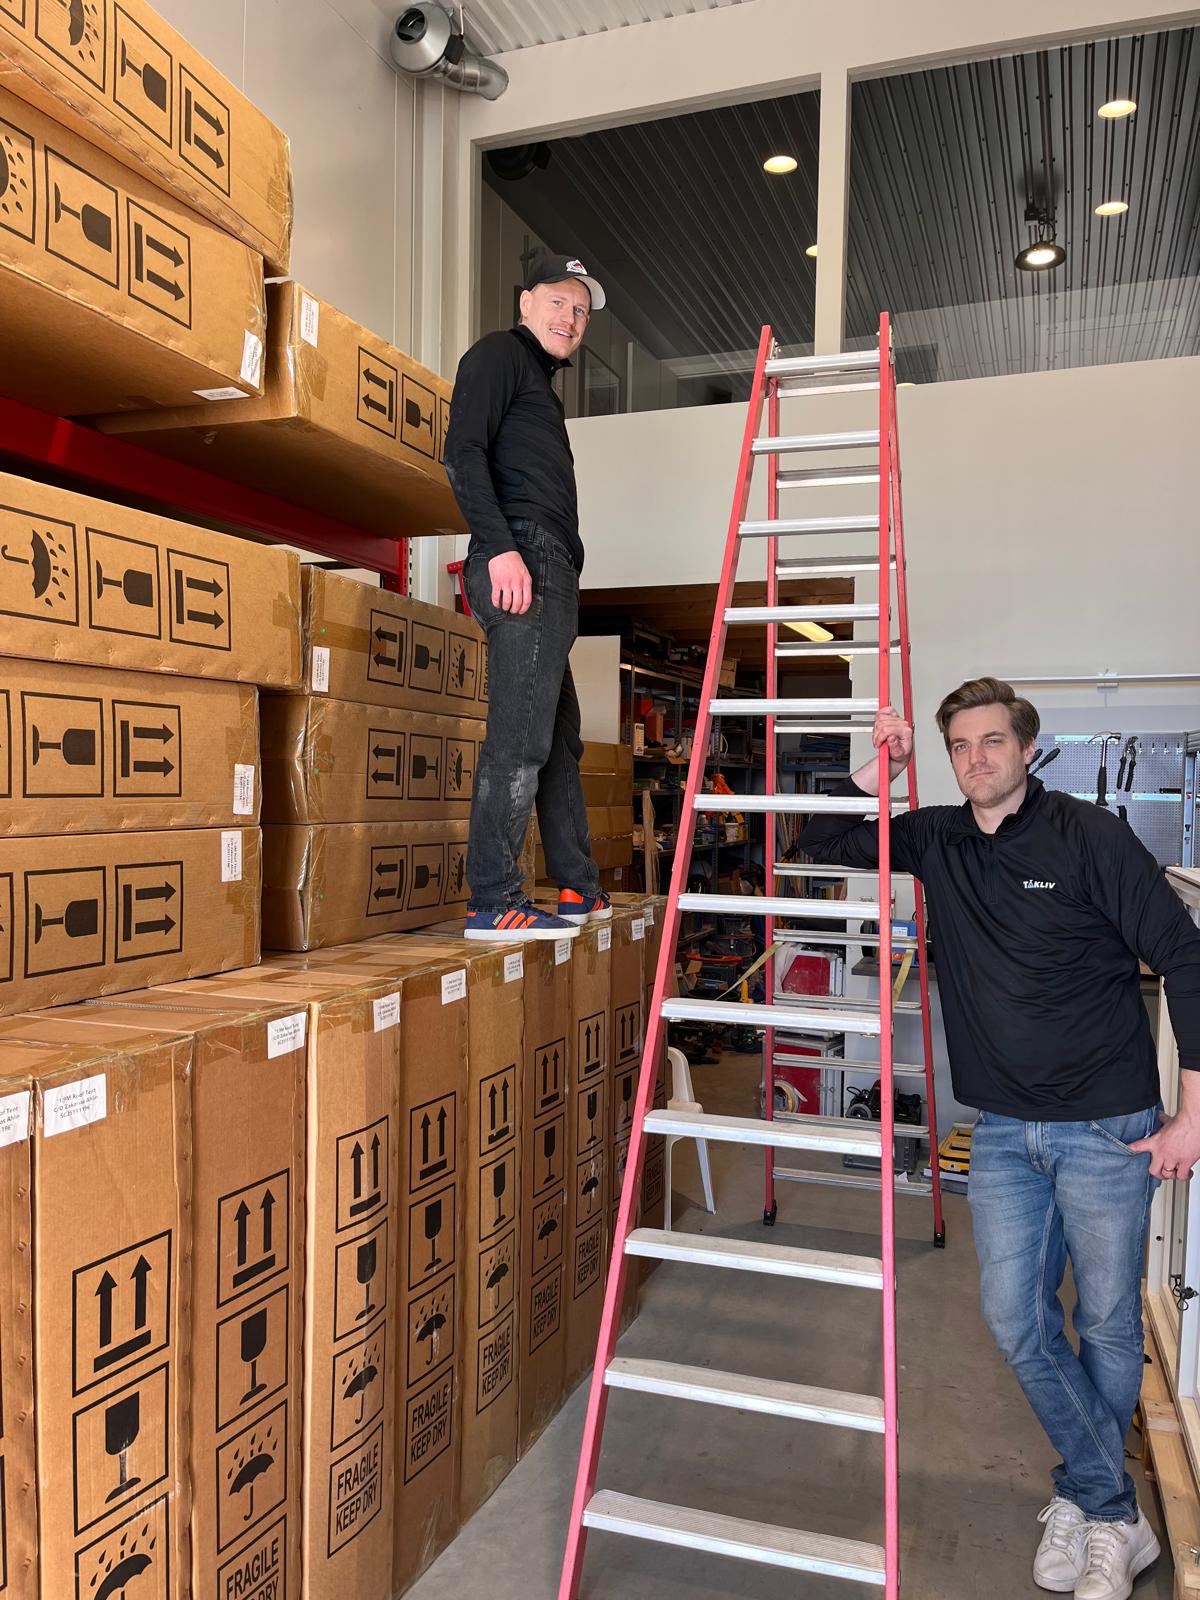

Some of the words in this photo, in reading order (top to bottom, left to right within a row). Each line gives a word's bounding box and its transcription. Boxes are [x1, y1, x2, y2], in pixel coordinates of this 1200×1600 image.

[534, 1277, 559, 1313] FRAGILE
[483, 1326, 510, 1368] FRAGILE
[482, 1367, 499, 1397] KEEP
[499, 1355, 510, 1381] DRY
[412, 1383, 448, 1432] FRAGILE
[410, 1429, 432, 1464] KEEP
[432, 1416, 447, 1446] DRY
[337, 1442, 379, 1500] FRAGILE
[336, 1497, 361, 1535] KEEP
[362, 1480, 378, 1513] DRY
[227, 1537, 279, 1600] FRAGILE
